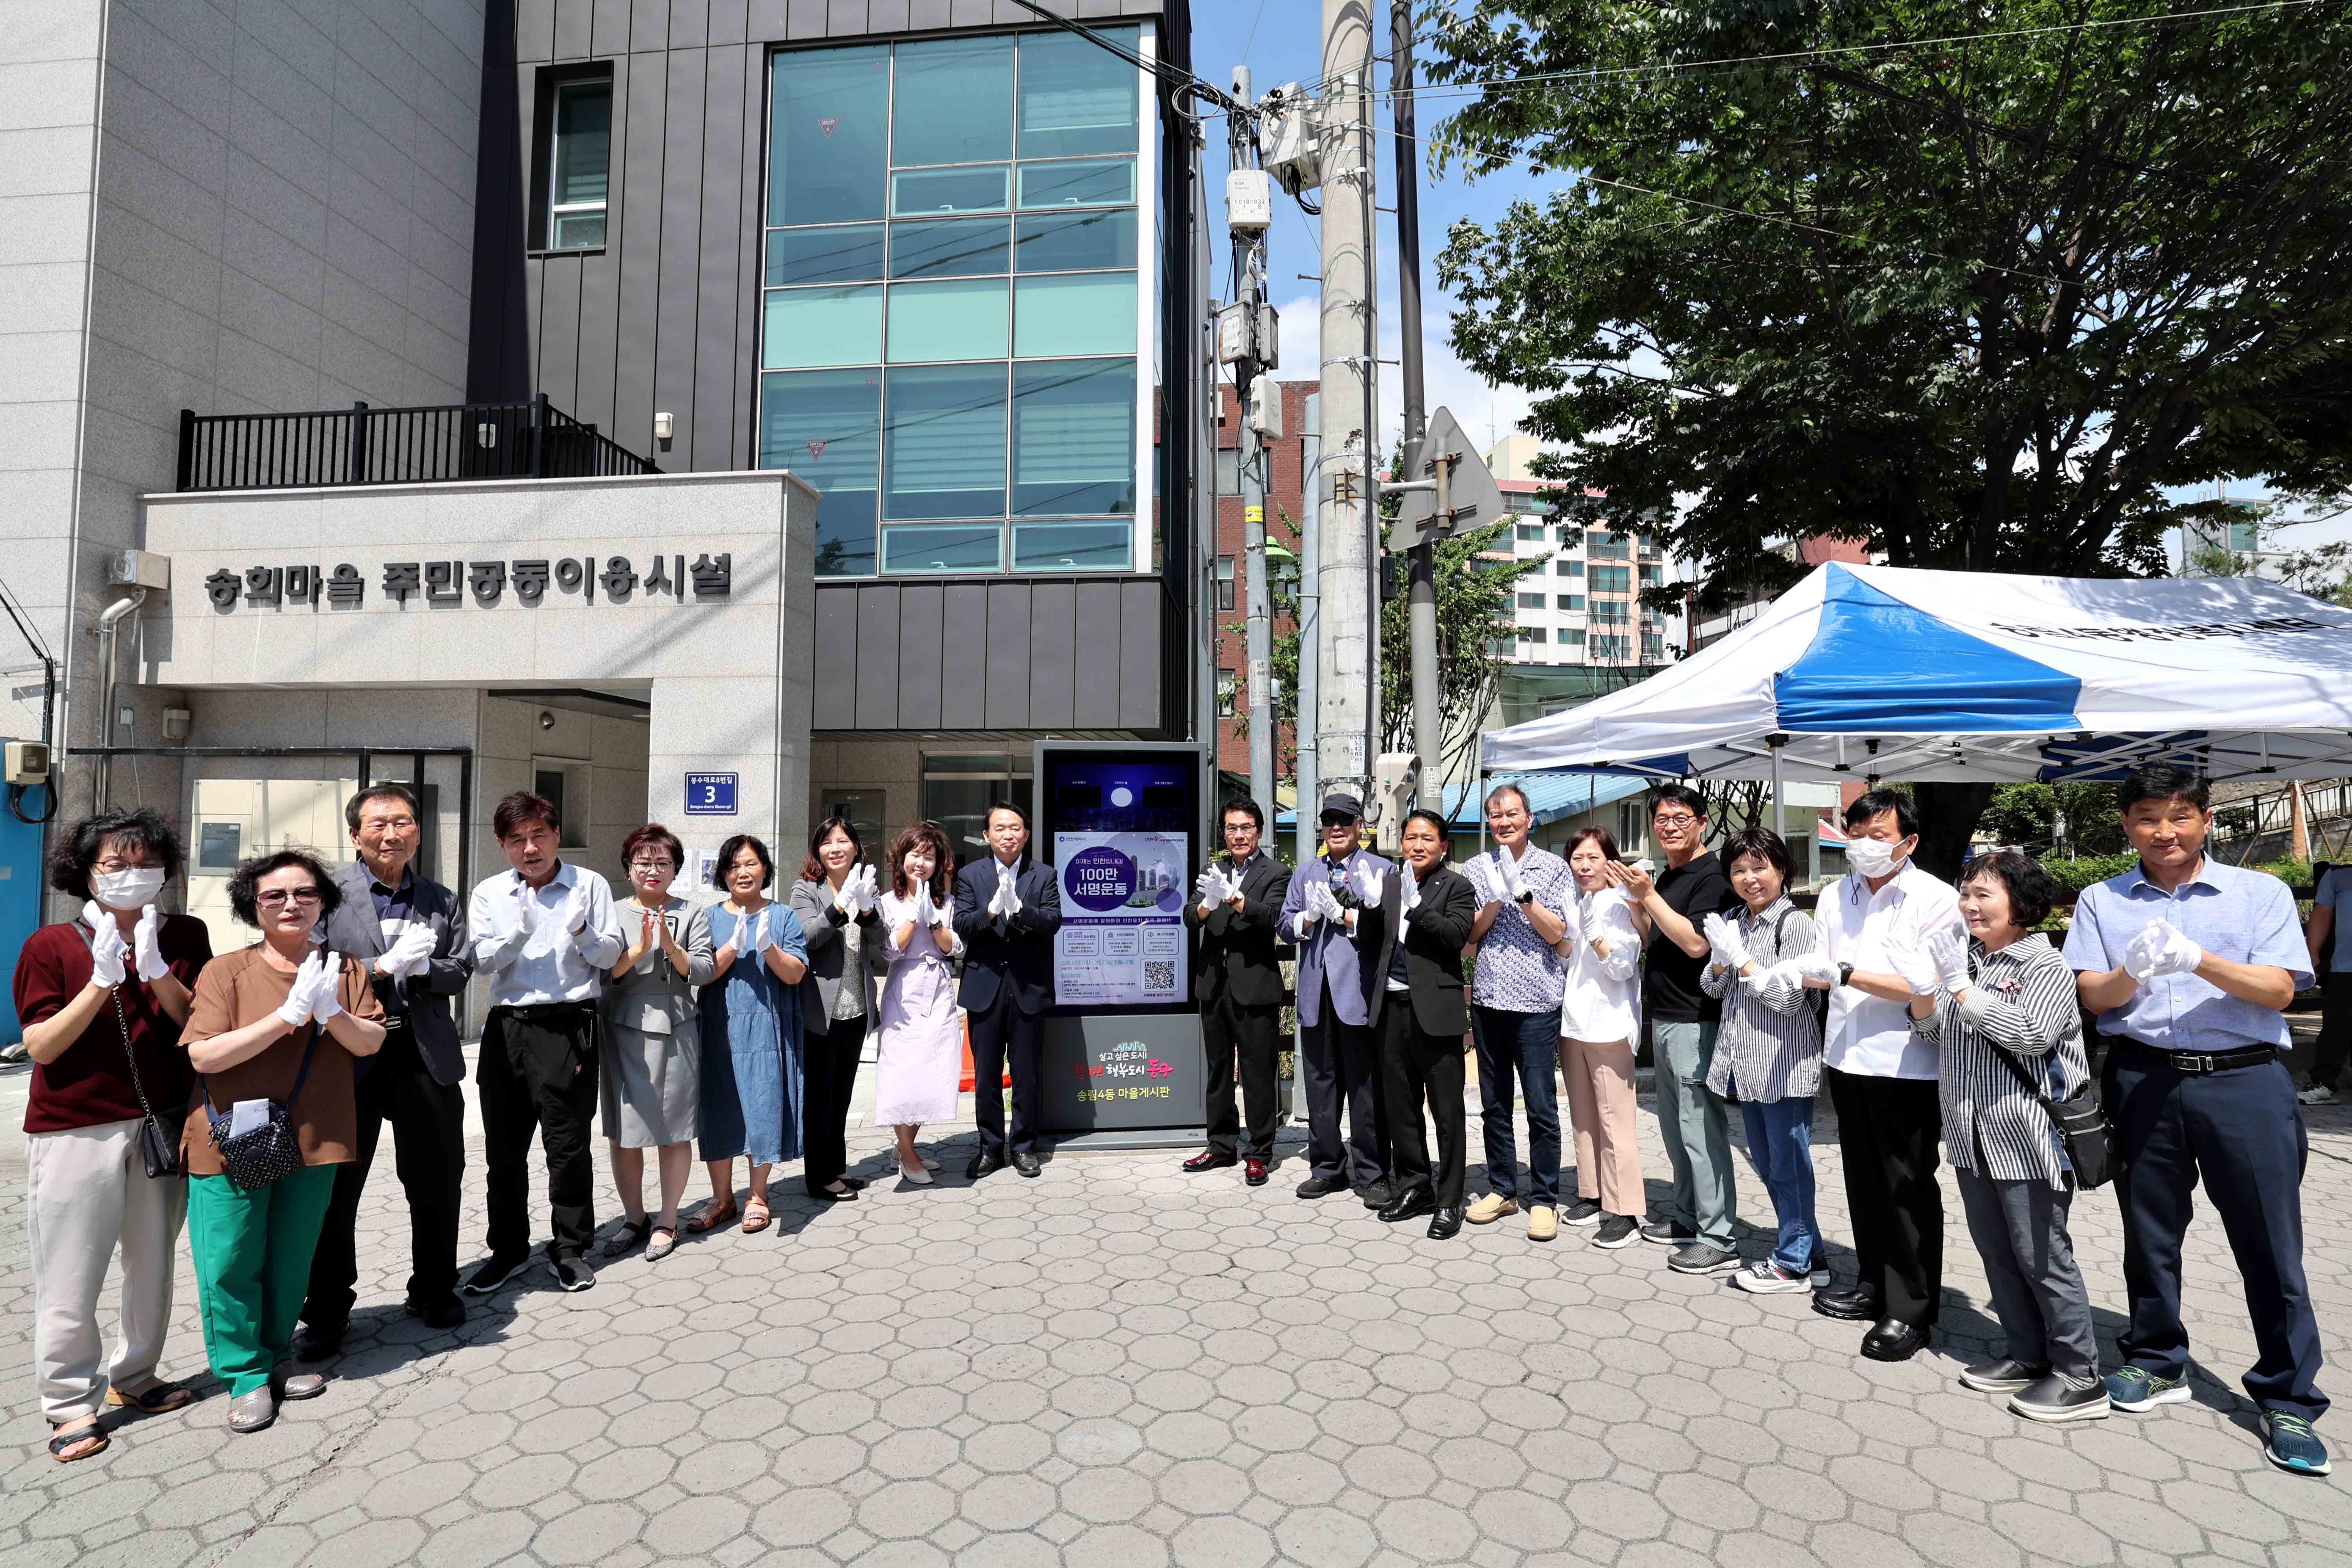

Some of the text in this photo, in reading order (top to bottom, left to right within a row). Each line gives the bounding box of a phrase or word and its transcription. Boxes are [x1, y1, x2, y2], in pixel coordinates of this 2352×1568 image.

[382, 554, 731, 602] 주민공동이용시설
[704, 786, 715, 803] 3
[1080, 868, 1118, 880] 100만
[1074, 883, 1127, 896] 서명운동
[1099, 1052, 1114, 1062] 살고
[1115, 1052, 1129, 1061] 싶은
[1106, 1063, 1144, 1078] 행복도시
[1146, 1059, 1173, 1078] 동구
[1077, 1086, 1170, 1102] 송림4동 마을게시판
